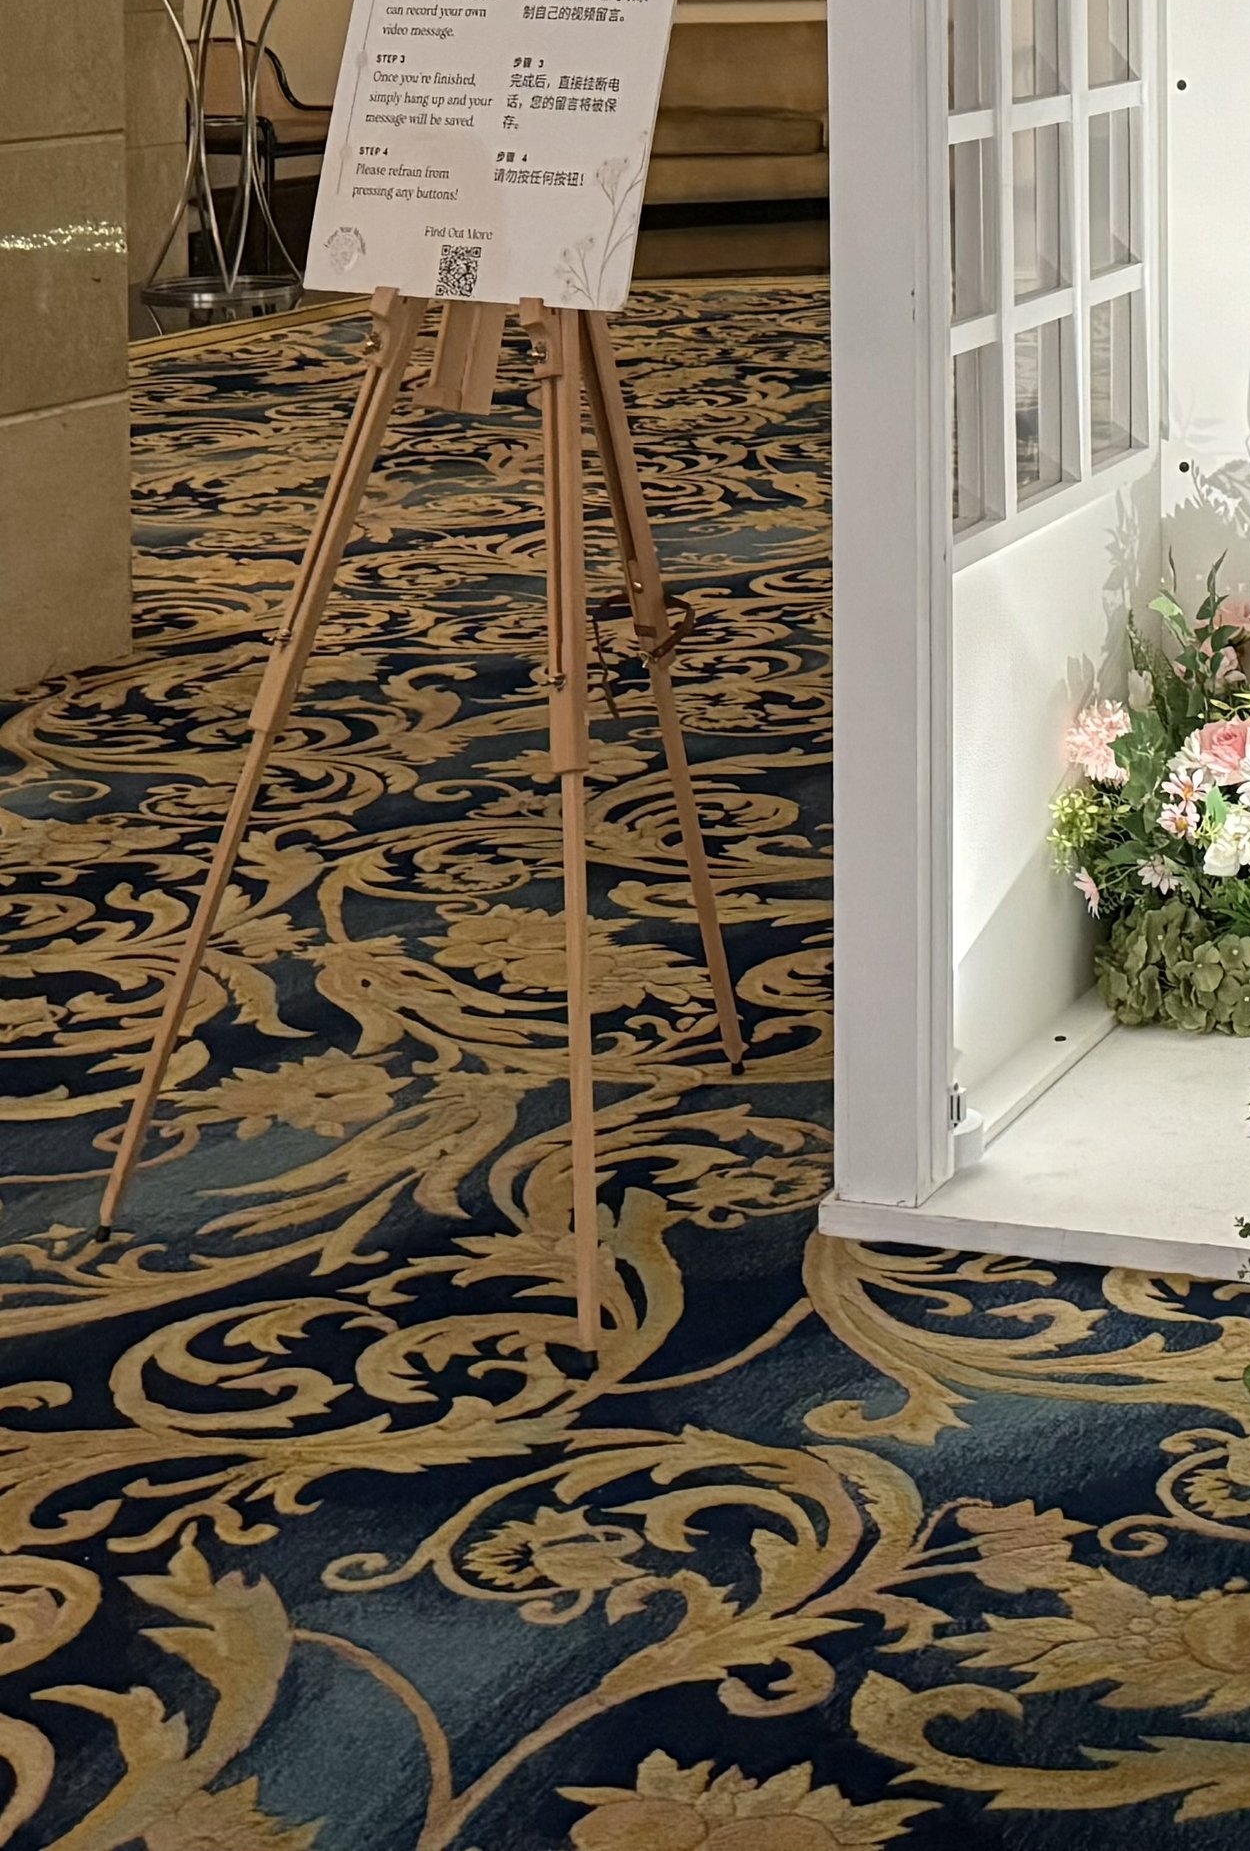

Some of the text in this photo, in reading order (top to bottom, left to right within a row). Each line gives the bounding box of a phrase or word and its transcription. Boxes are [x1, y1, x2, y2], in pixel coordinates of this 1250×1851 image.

[386, 4, 486, 19] can record your own
[382, 23, 454, 40] video message.
[376, 54, 398, 64] STEP
[513, 57, 532, 68] 步骤
[373, 70, 399, 83] Once
[368, 91, 493, 109] simply hang up and your
[365, 113, 407, 127] message
[409, 113, 428, 125] will
[430, 114, 443, 126] be
[359, 146, 380, 156] STEP
[496, 151, 515, 162] 步骤
[355, 163, 450, 179] Please refrain from
[352, 186, 459, 201] pressing any buttons!
[424, 225, 493, 240] Find Out More
